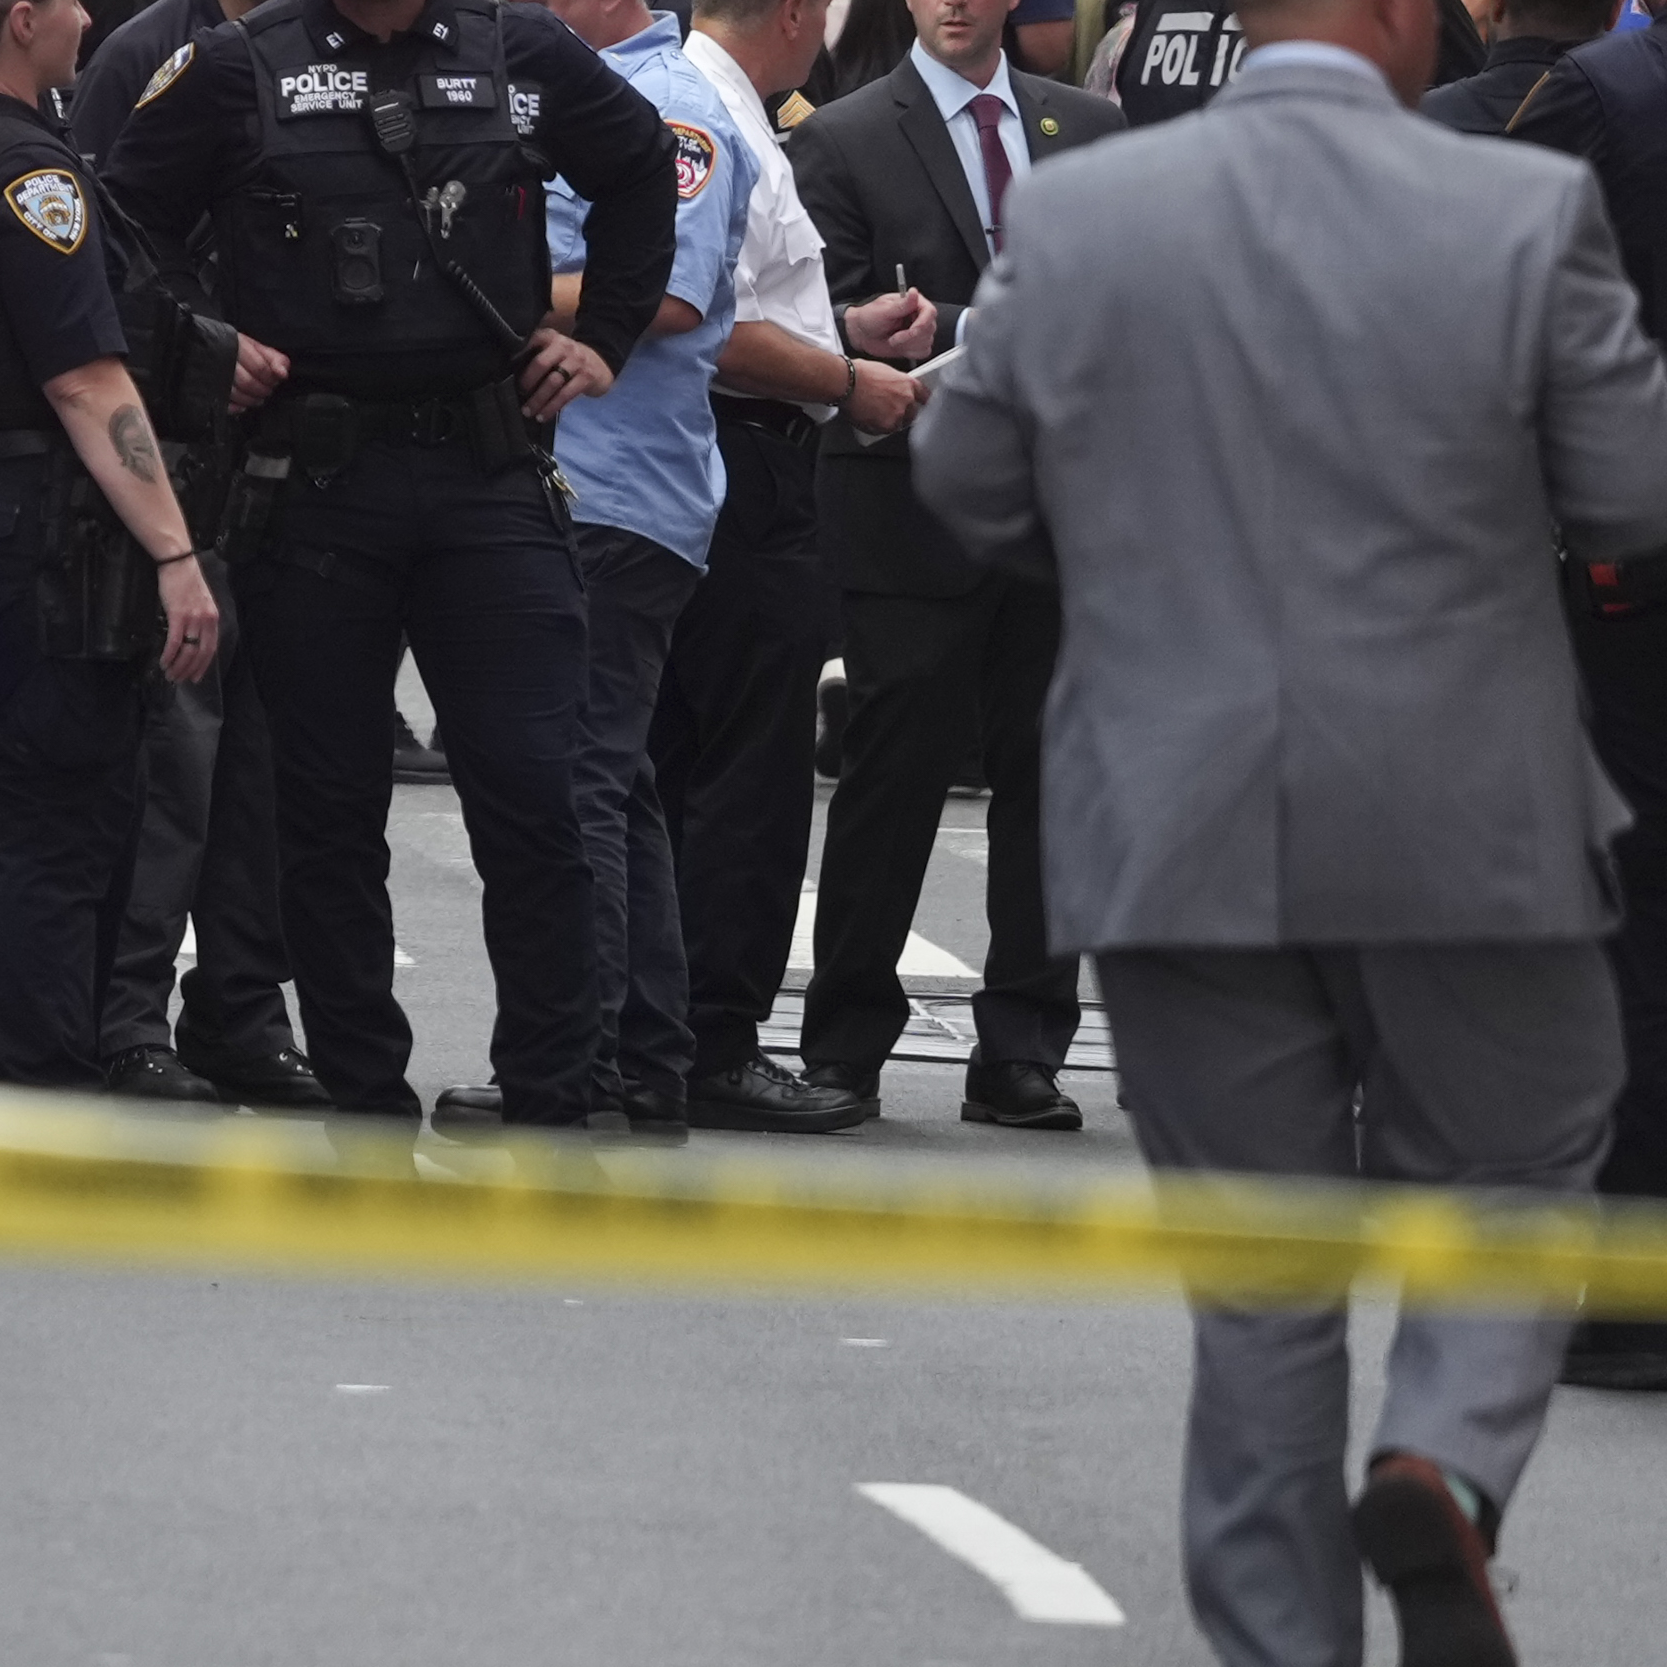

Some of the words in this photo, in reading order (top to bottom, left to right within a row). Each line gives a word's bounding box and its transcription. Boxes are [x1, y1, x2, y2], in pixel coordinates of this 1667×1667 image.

[307, 64, 338, 74] NYPD
[280, 71, 368, 98] POLICE
[436, 77, 476, 89] BURTT
[293, 91, 356, 104] EMERGENCY
[446, 90, 473, 103] 1960
[290, 100, 333, 113] SERVICE
[338, 99, 363, 109] UNIT
[24, 174, 60, 189] POLICE
[16, 182, 75, 206] DEPARTMENT
